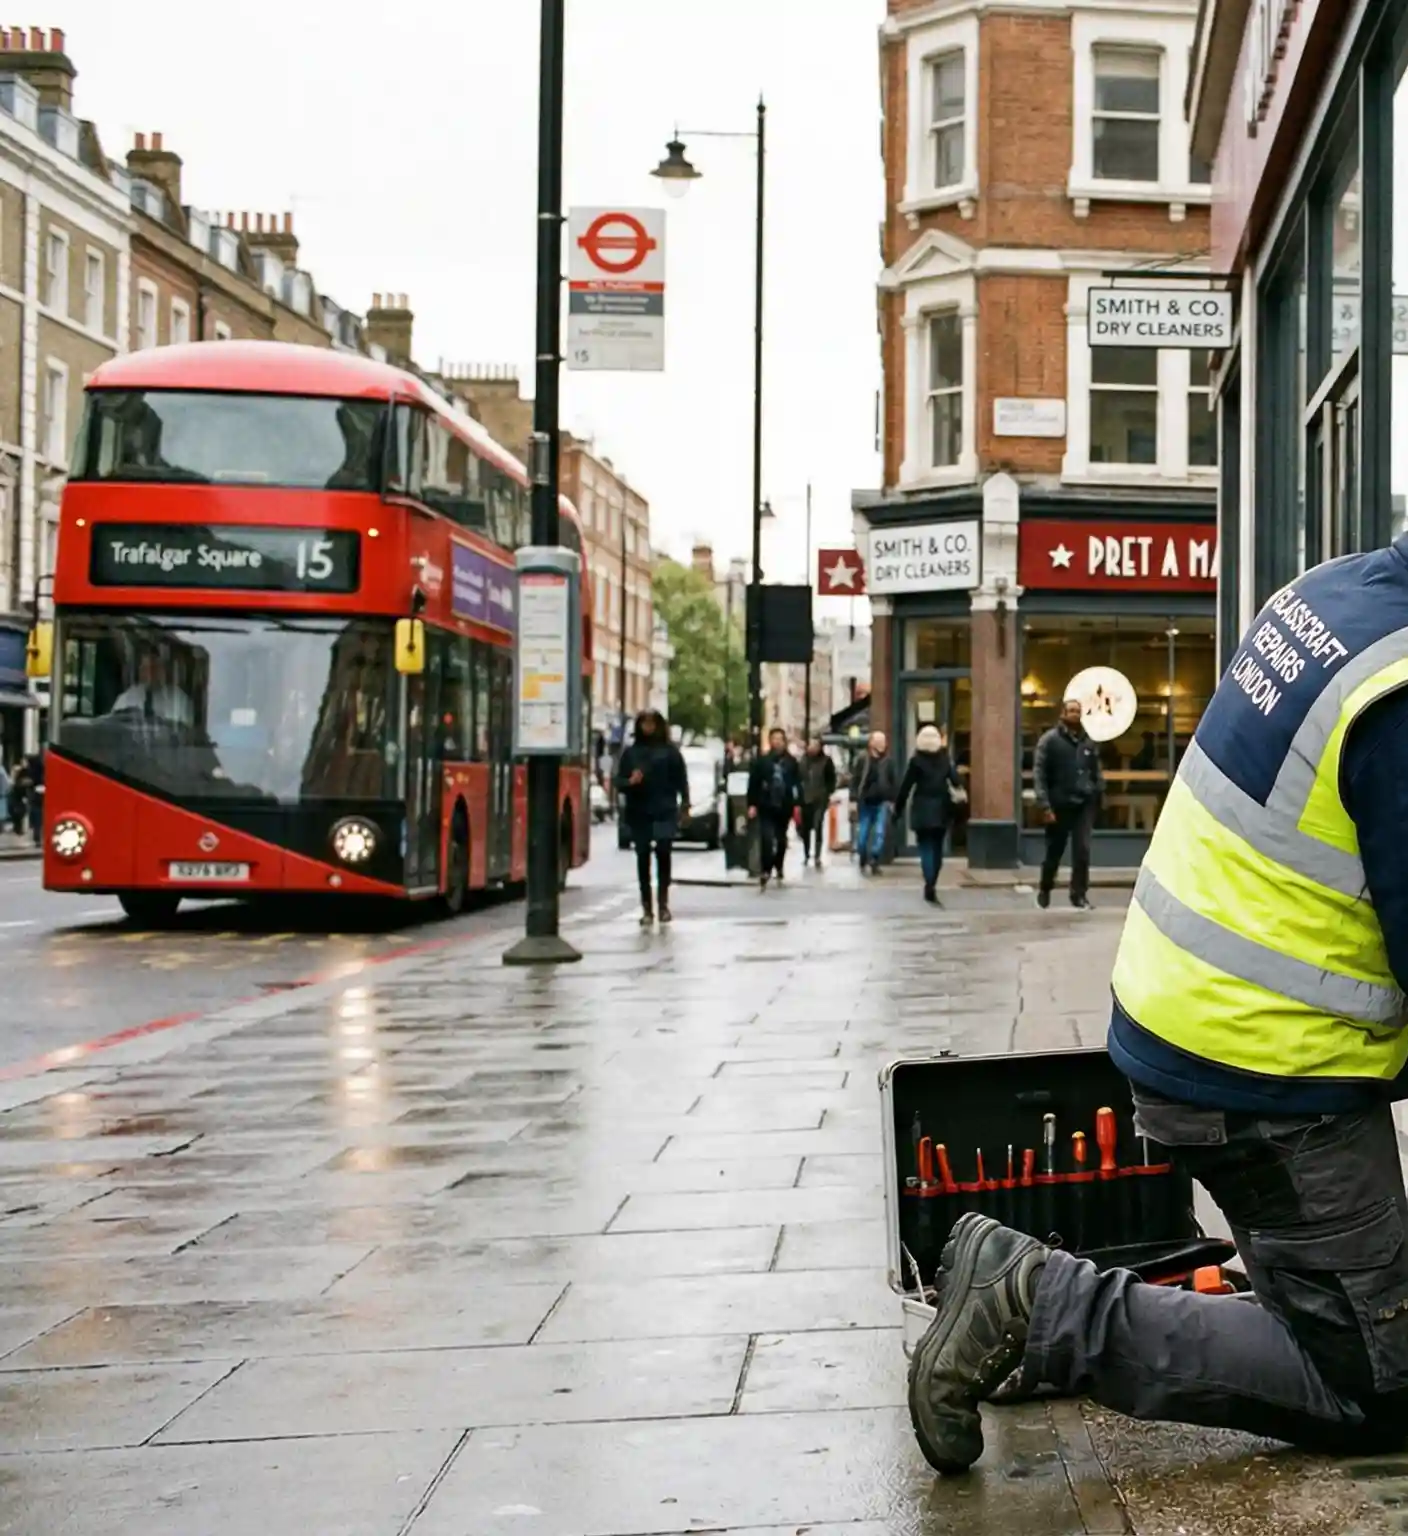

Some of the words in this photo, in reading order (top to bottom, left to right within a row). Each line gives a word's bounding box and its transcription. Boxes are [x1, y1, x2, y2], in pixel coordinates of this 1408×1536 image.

[1096, 298, 1160, 316] SMITH
[1166, 299, 1181, 316] &
[1188, 299, 1224, 317] CO.
[1096, 321, 1131, 336] DRY
[1136, 321, 1224, 338] CLEANERS
[110, 541, 192, 572] Trafalgar
[197, 543, 263, 572] Square
[295, 540, 334, 579] 15
[873, 536, 923, 559] SMITH
[928, 535, 938, 554] &
[945, 533, 972, 552] CO.
[1087, 535, 1153, 577] PRET
[1160, 536, 1180, 577] A
[875, 562, 901, 581] DRY
[904, 558, 971, 580] CLEANERS
[1252, 621, 1306, 684] REPAIRS
[1231, 650, 1282, 716] LONDON
